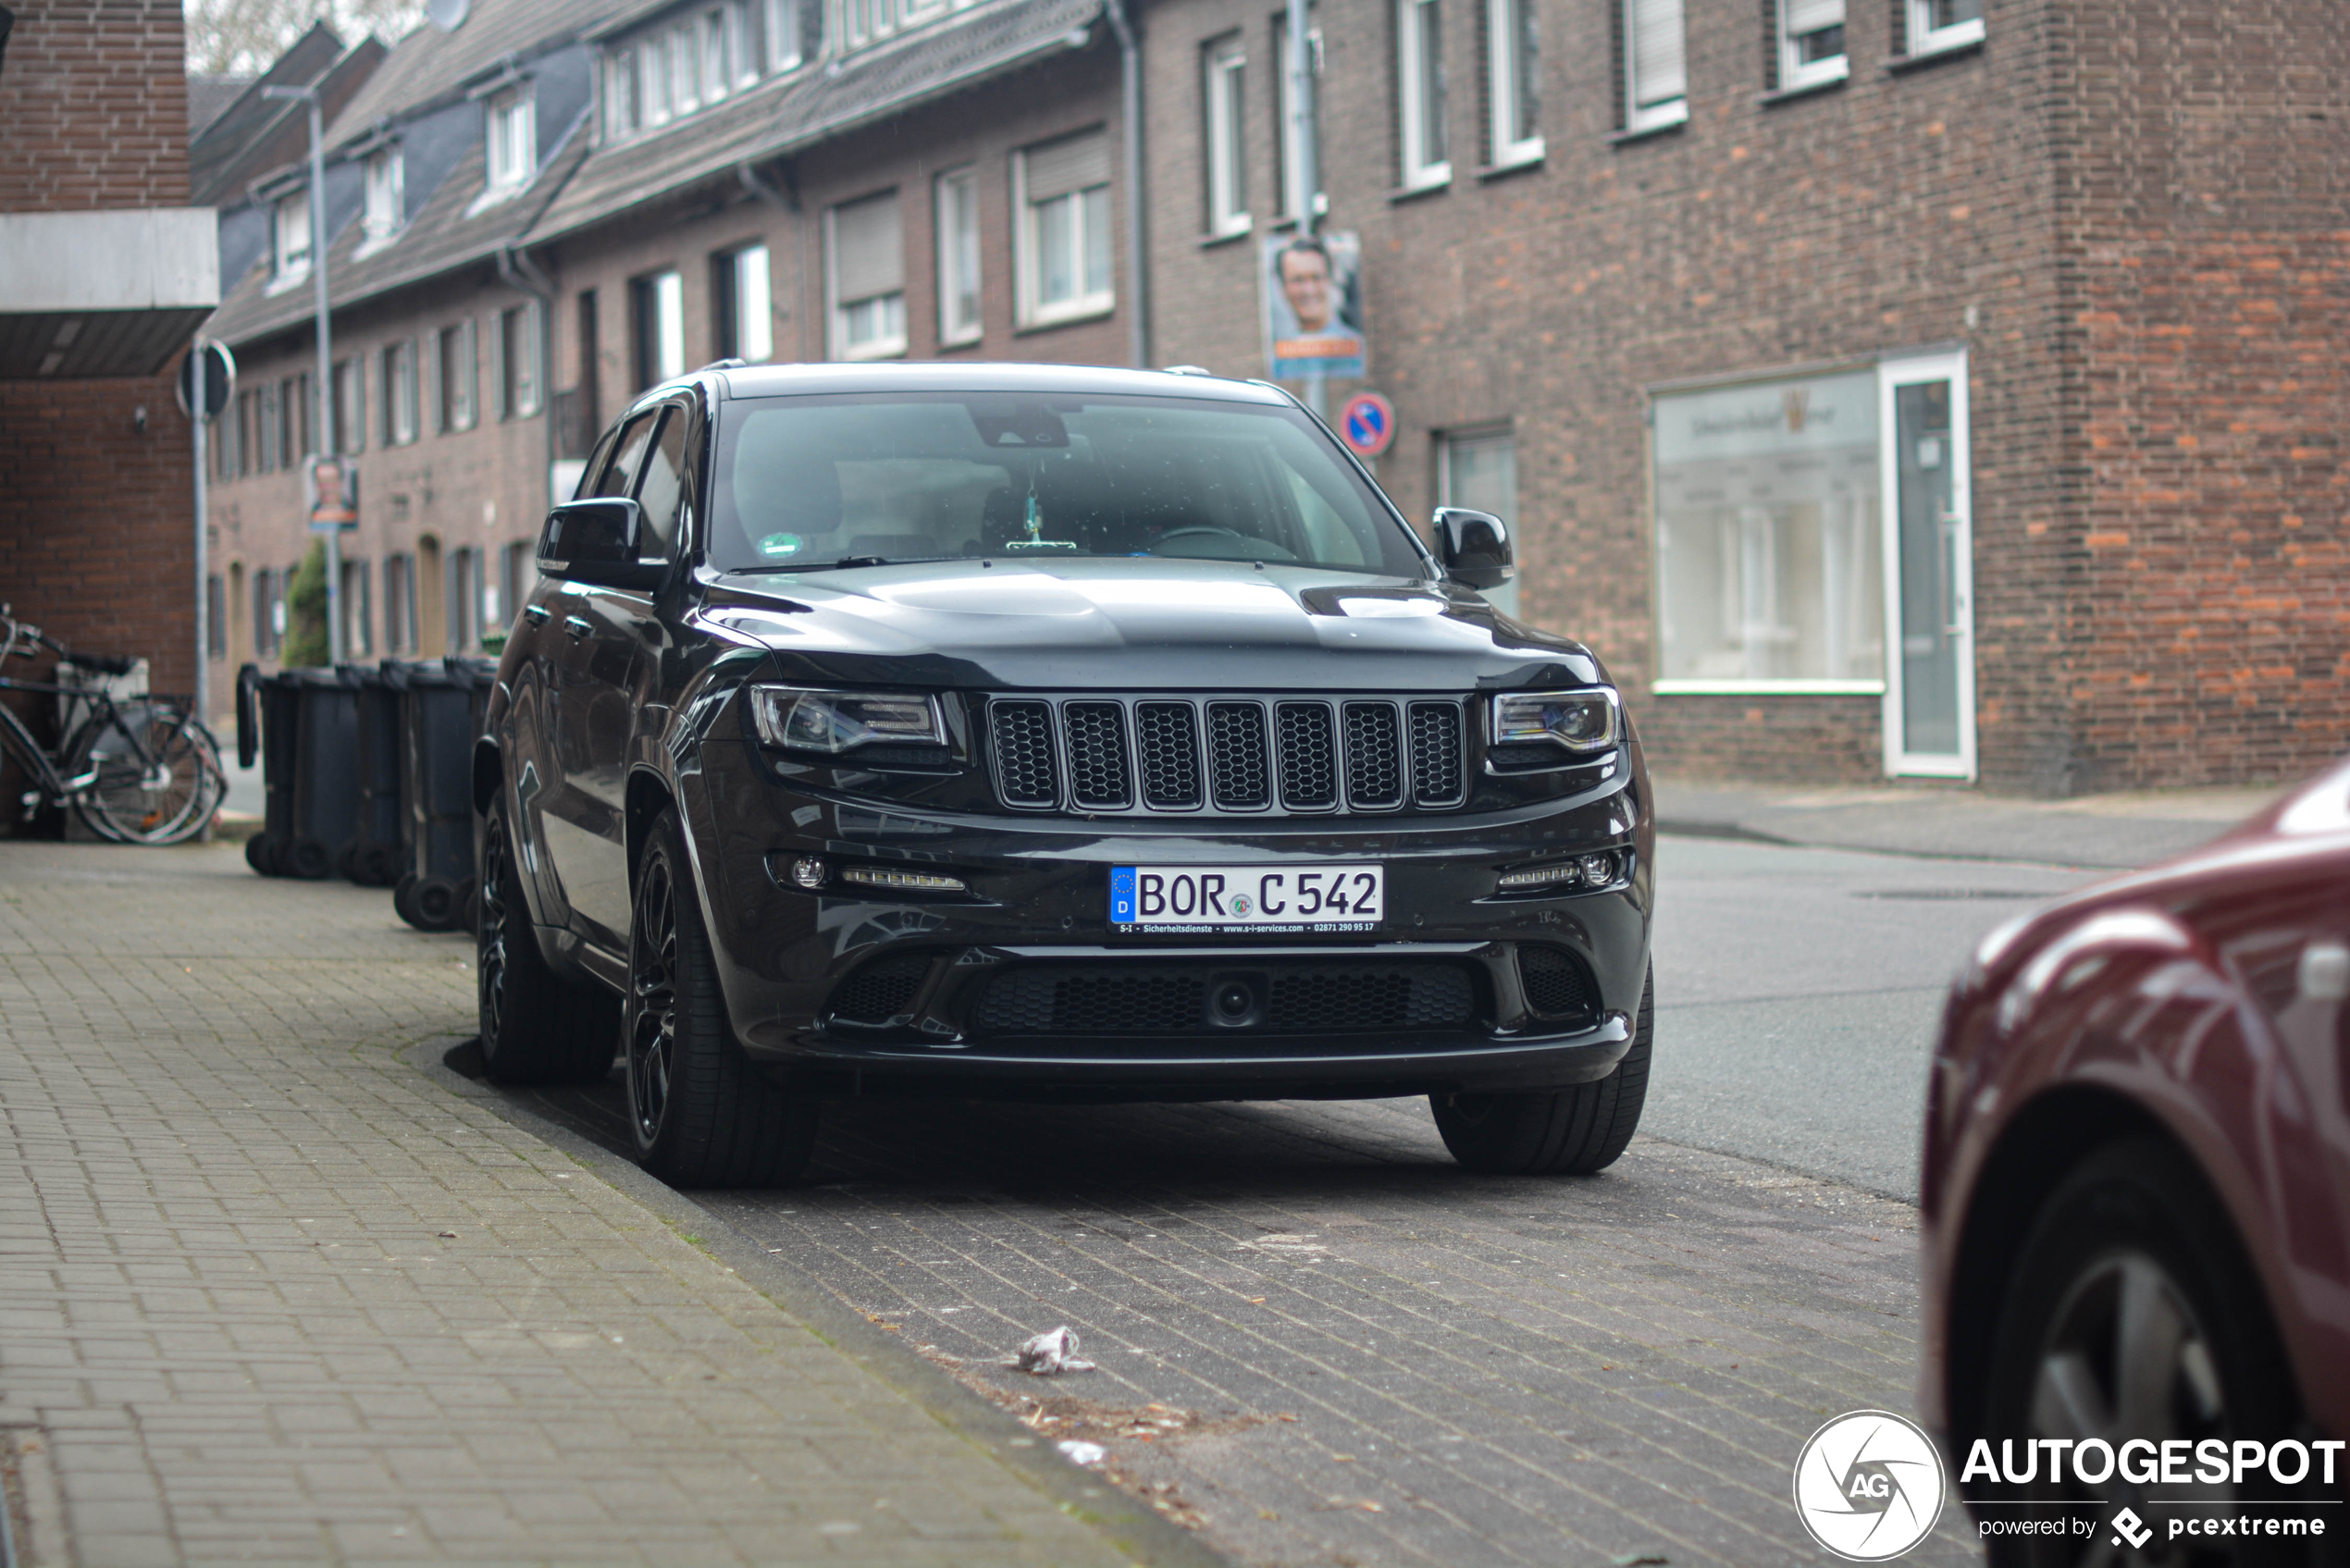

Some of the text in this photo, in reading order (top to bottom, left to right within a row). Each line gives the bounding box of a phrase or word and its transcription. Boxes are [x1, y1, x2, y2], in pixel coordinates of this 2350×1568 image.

[1139, 872, 1378, 916] BOR C 542
[1118, 901, 1129, 913] D
[1119, 924, 1132, 932] S-I
[1144, 924, 1213, 933] Sicherheitsdienste
[1223, 924, 1304, 933] www.s-i-services.com
[1314, 923, 1337, 932] 02871
[1339, 923, 1352, 932] 290
[1365, 922, 1374, 931] 17
